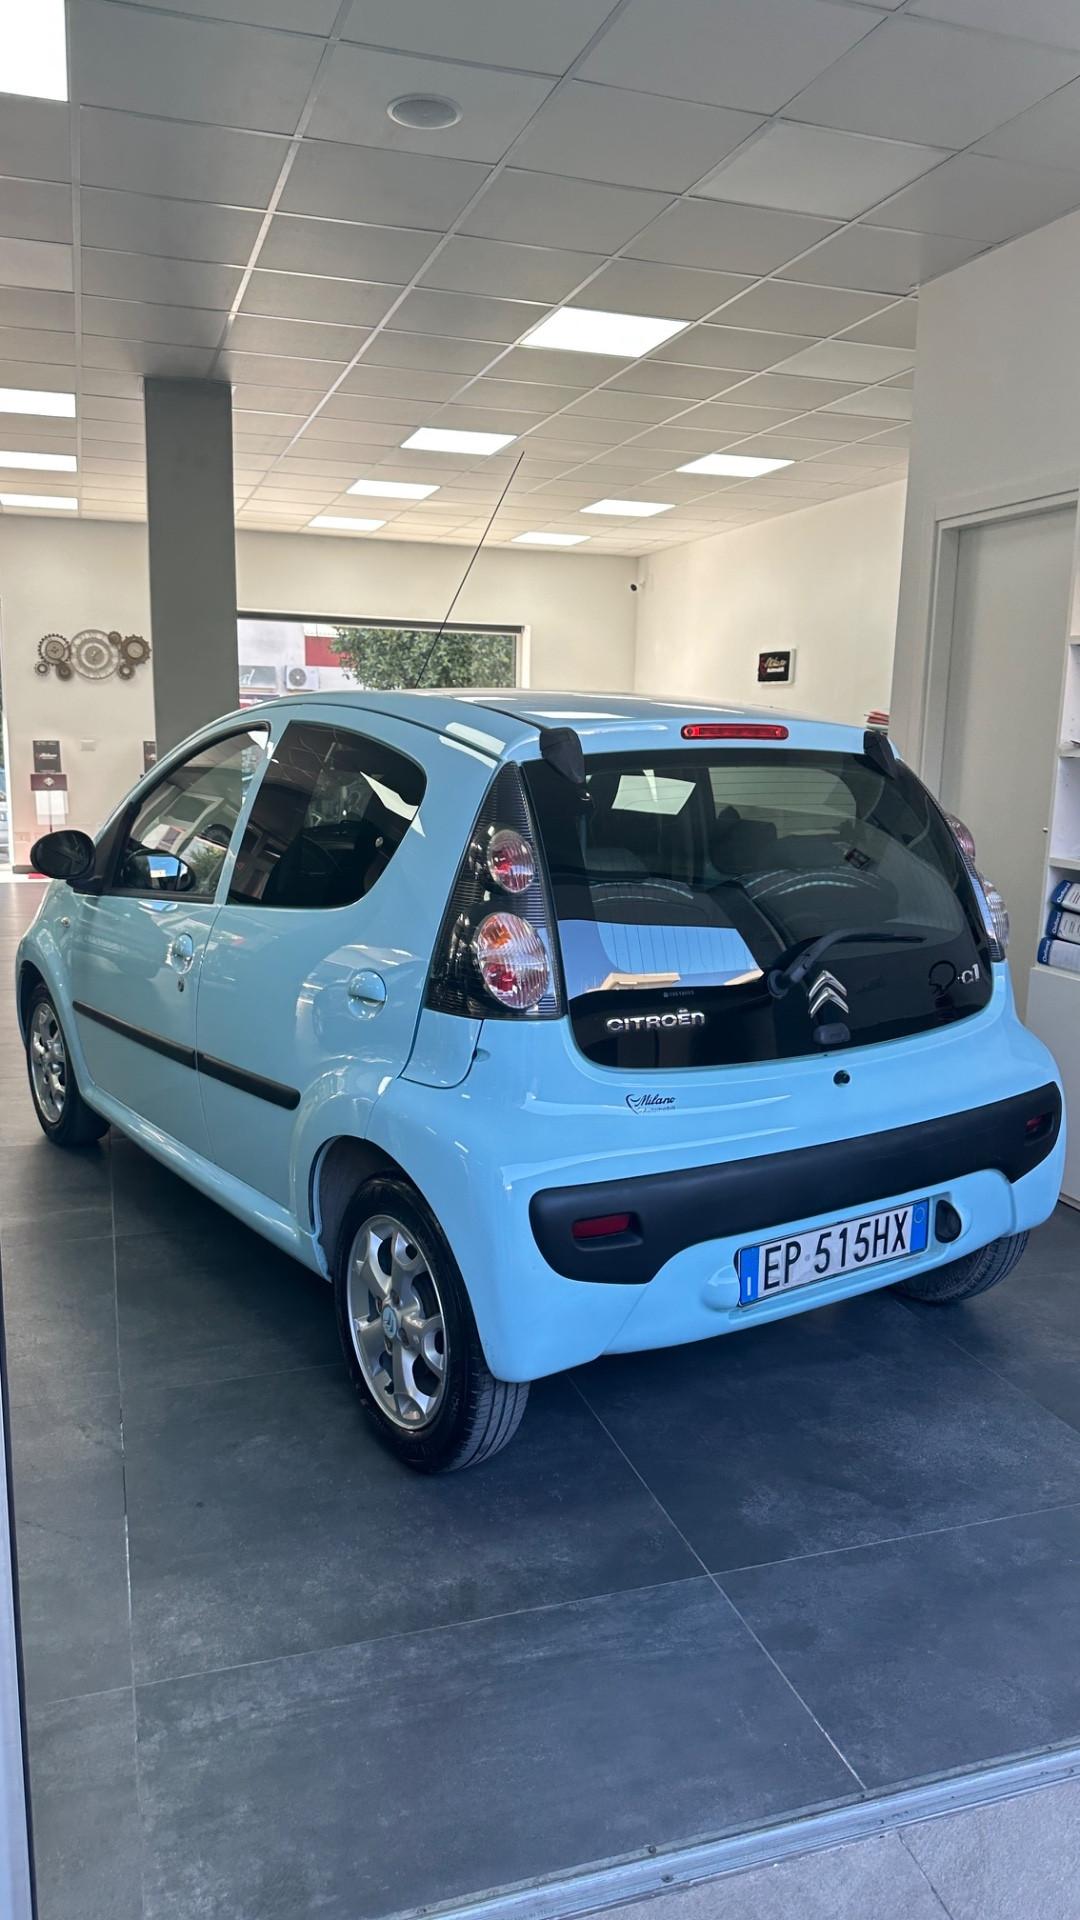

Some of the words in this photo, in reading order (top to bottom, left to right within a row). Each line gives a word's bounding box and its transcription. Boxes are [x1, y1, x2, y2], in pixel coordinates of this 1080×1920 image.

[606, 1008, 705, 1031] CITROËN
[635, 1093, 676, 1107] Milano
[764, 1240, 802, 1290] EP
[814, 1210, 909, 1274] 515HX
